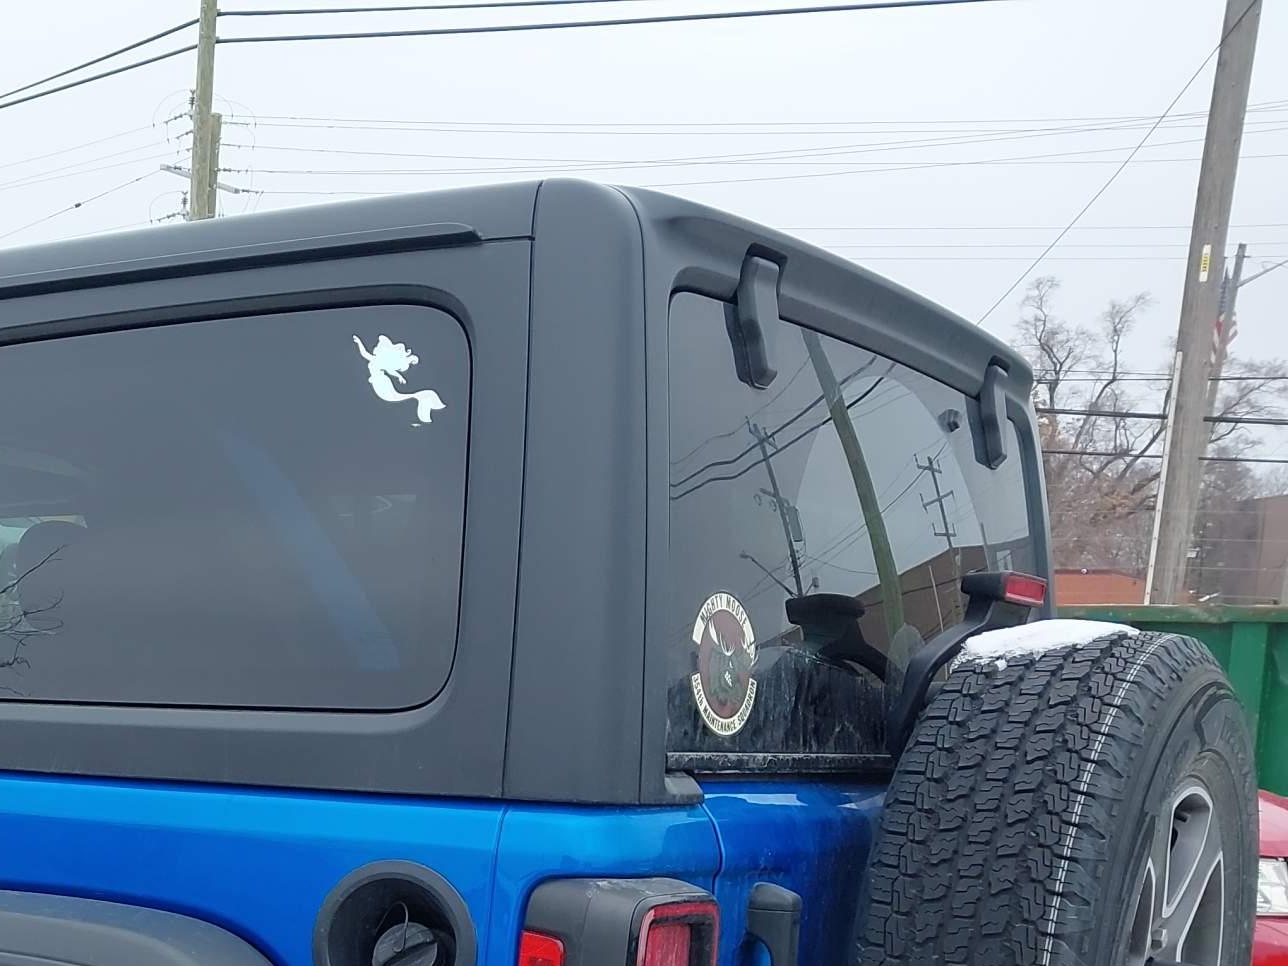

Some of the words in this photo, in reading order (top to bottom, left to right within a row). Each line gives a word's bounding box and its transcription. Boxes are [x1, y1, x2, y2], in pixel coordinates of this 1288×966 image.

[698, 593, 724, 626] MIGHTY
[725, 594, 747, 626] MOOSE
[702, 704, 737, 733] MAINTENANCE
[736, 680, 757, 727] SQUADRON
